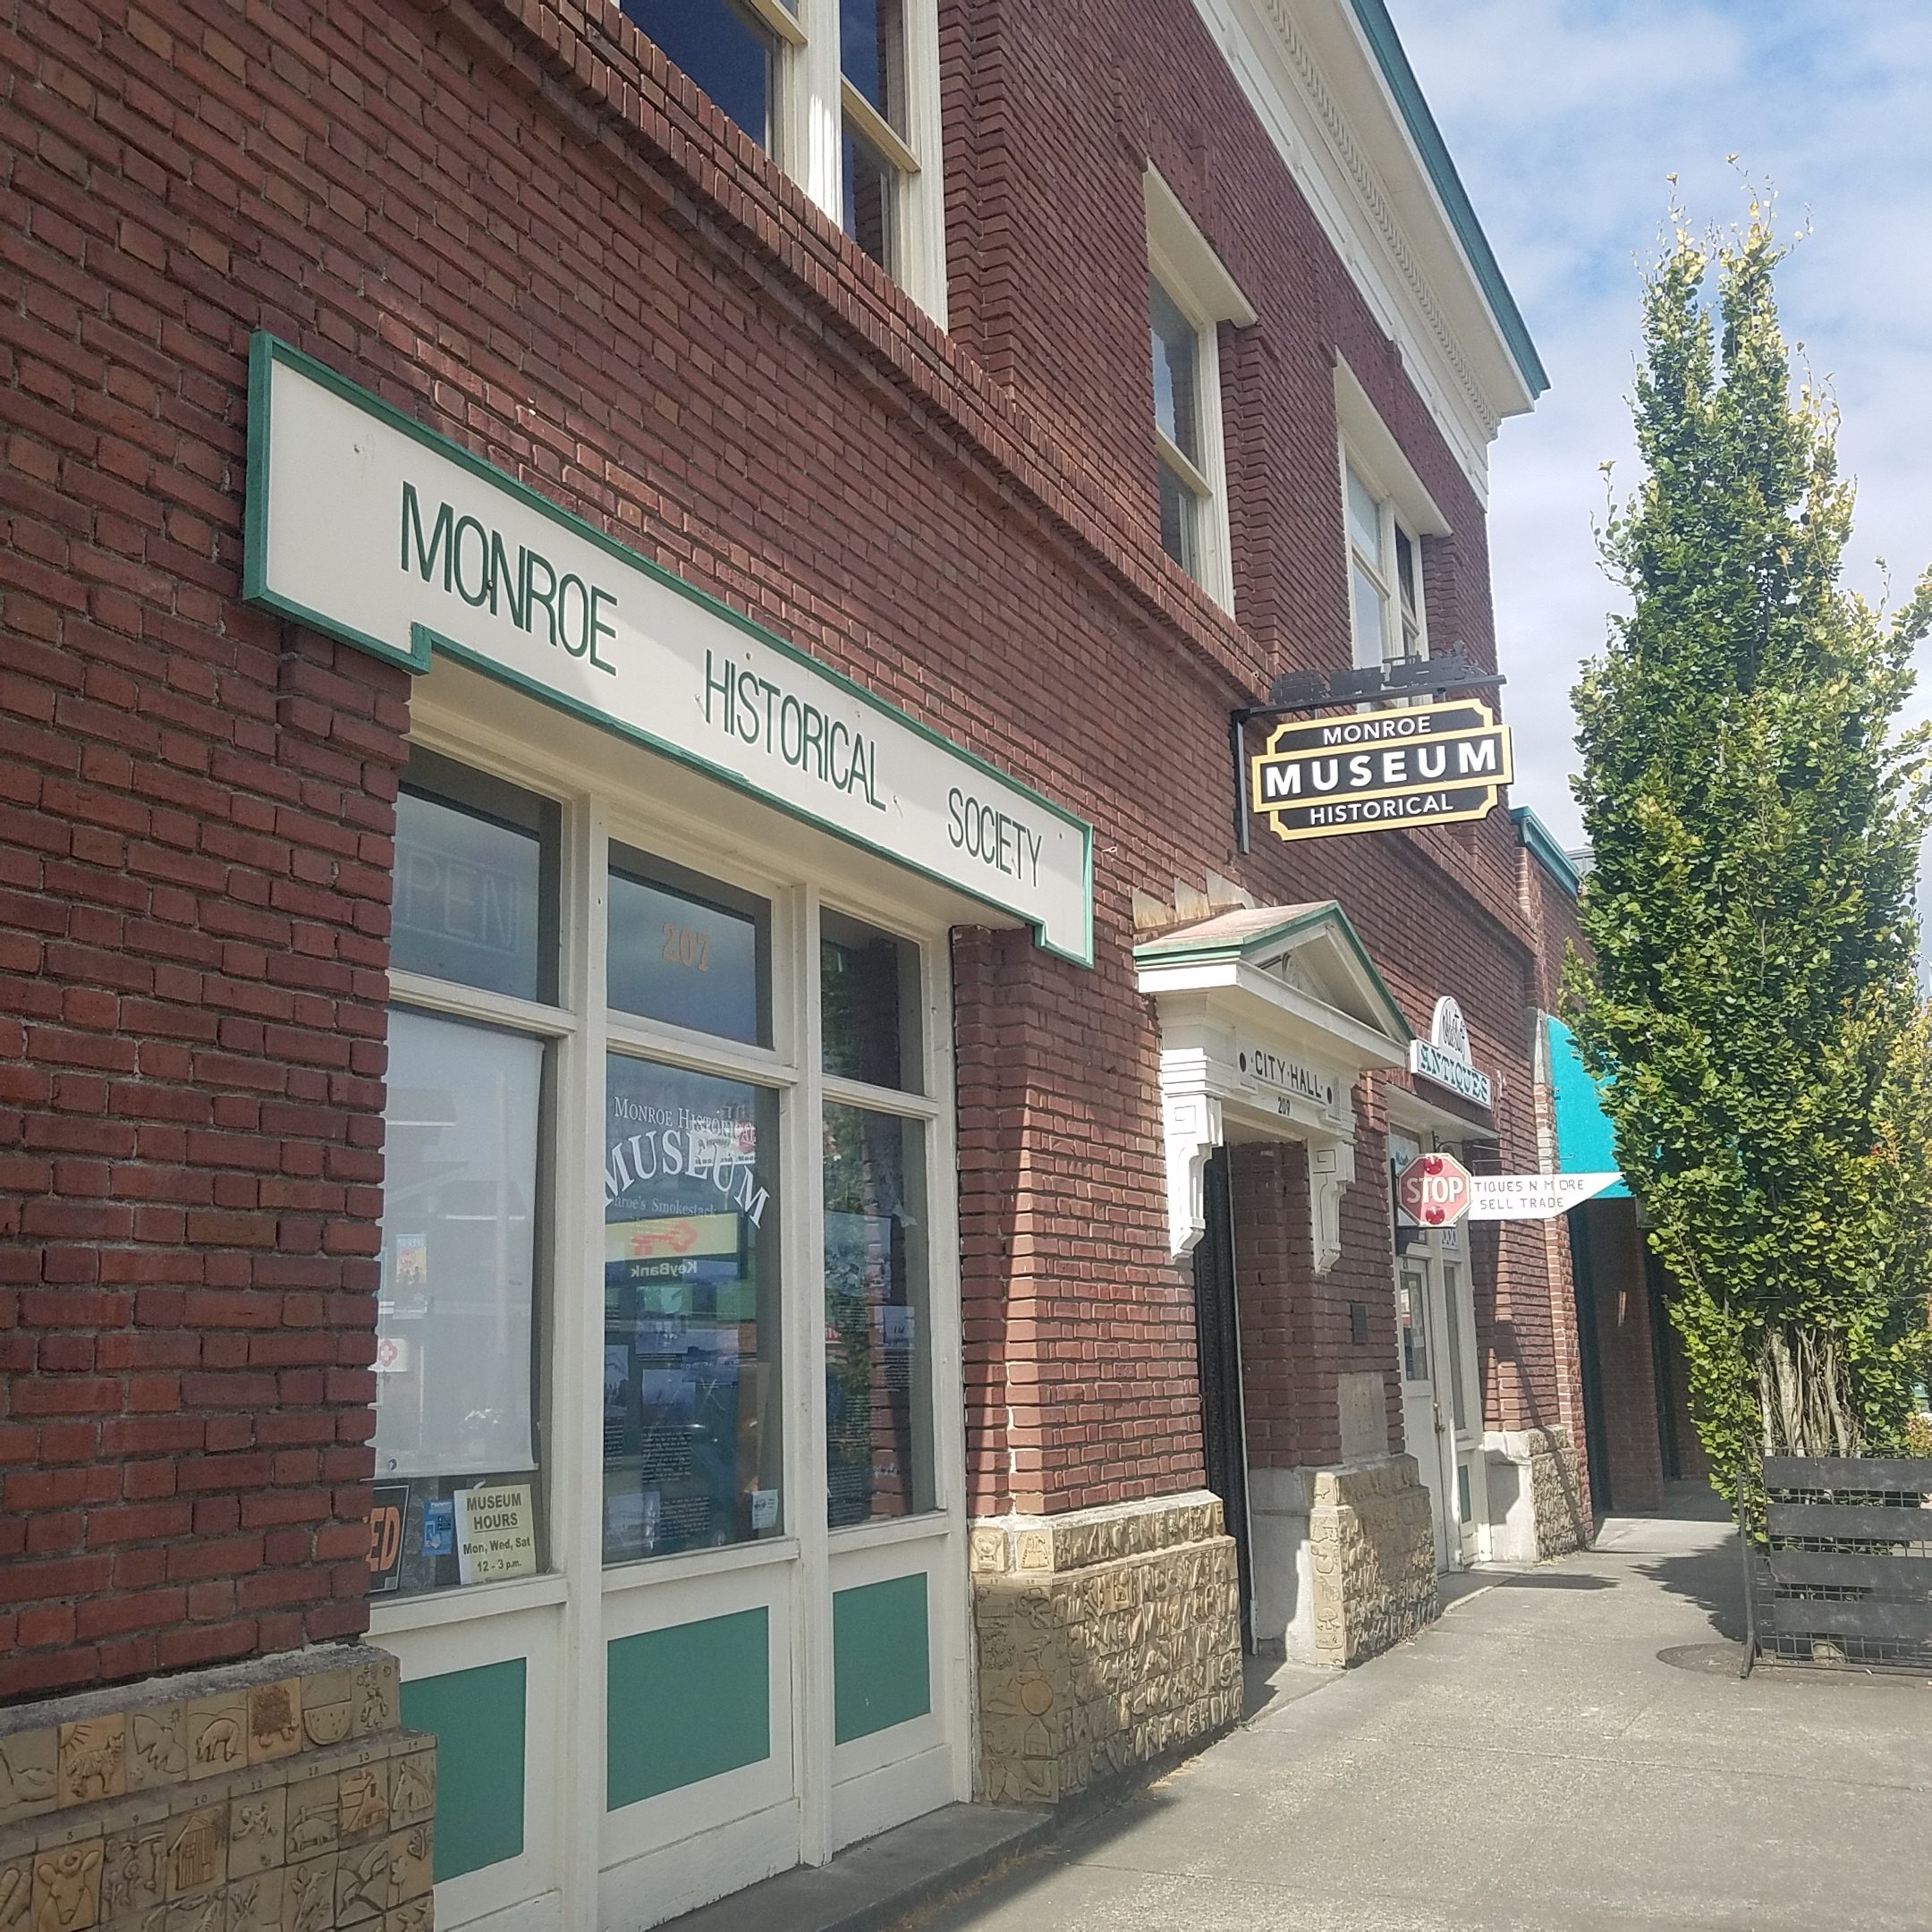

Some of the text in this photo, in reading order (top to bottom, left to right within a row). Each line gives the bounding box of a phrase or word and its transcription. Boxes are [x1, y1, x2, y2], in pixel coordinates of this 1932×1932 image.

[399, 481, 1043, 886] MONROE HISTORICAL SOCIETY
[1323, 716, 1431, 745] MONROE
[1266, 739, 1496, 797] MUSEUM
[1309, 793, 1453, 826] HISTORICAL
[394, 852, 513, 946] PEN
[662, 922, 709, 971] 207
[1420, 1044, 1487, 1103] ANTIQUES
[1277, 1097, 1291, 1116] 209
[605, 1129, 771, 1229] MUSEUM
[1406, 1176, 1463, 1204] STOP
[1474, 1181, 1523, 1193] TIQUES
[1529, 1181, 1538, 1191] N
[1479, 1197, 1564, 1210] SELL TRADE
[466, 1493, 521, 1512] MUSEUM
[474, 1513, 519, 1530] HOURS
[463, 1537, 530, 1555] Mon, Wed, Sat
[477, 1561, 489, 1572] 12
[497, 1559, 504, 1570] 3
[193, 1794, 208, 1806] 10
